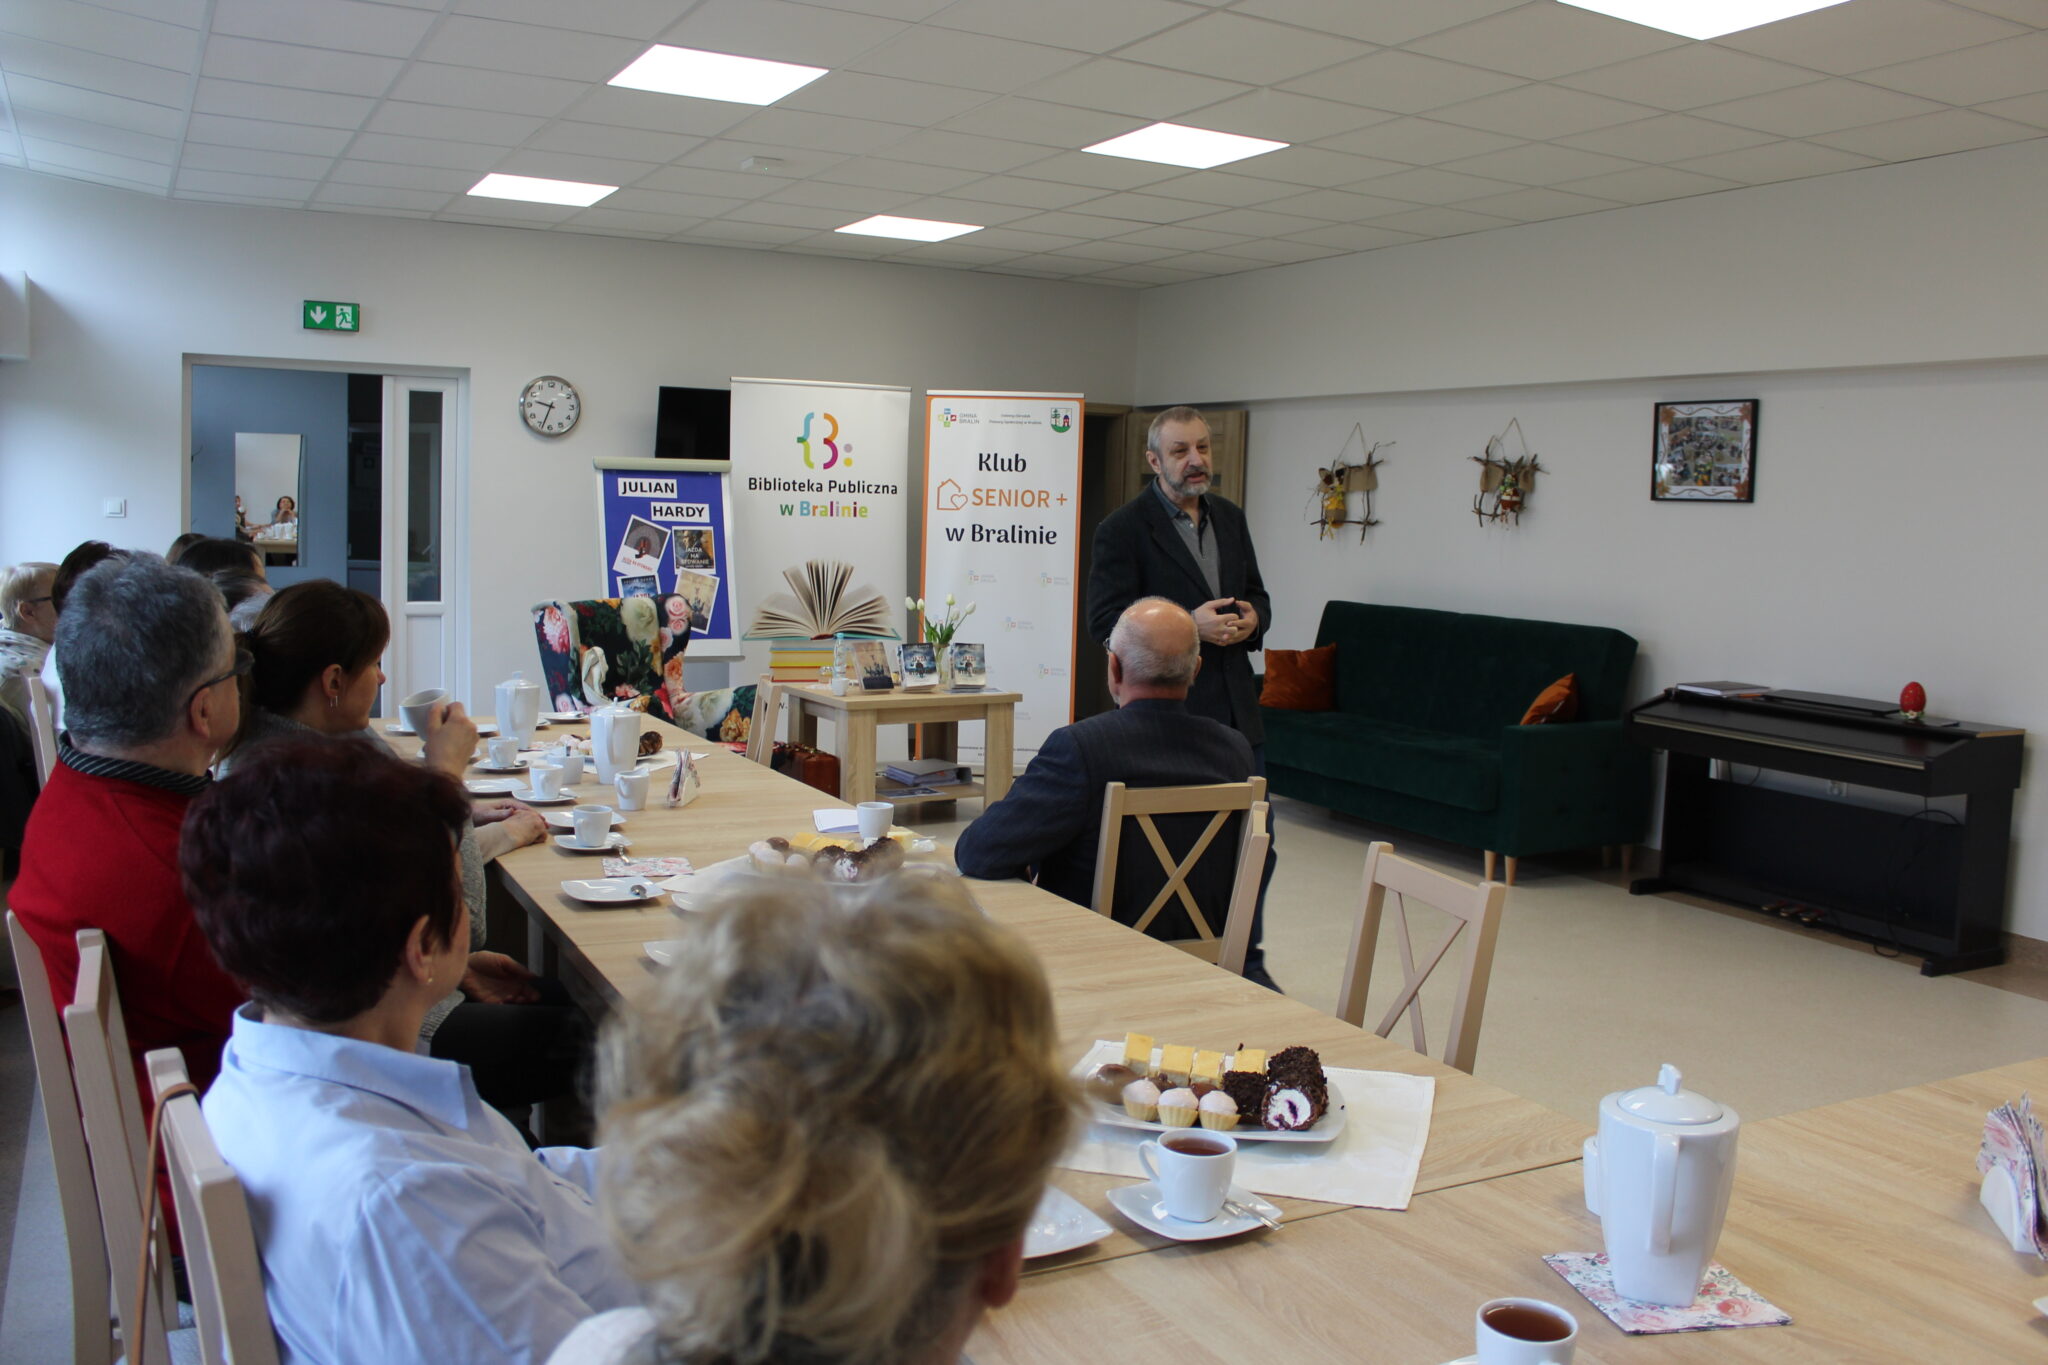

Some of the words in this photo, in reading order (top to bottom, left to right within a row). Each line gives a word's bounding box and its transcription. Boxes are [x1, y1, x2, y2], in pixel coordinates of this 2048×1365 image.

[978, 453, 1027, 473] Klub
[622, 481, 675, 495] JULIAN
[748, 477, 823, 493] Biblioteka
[828, 480, 898, 495] Publiczna
[971, 488, 1050, 508] SENIOR
[652, 505, 705, 518] HARDY
[780, 503, 794, 517] w
[799, 500, 868, 518] Bralinie
[945, 527, 965, 542] w
[971, 523, 1057, 545] Bralinie
